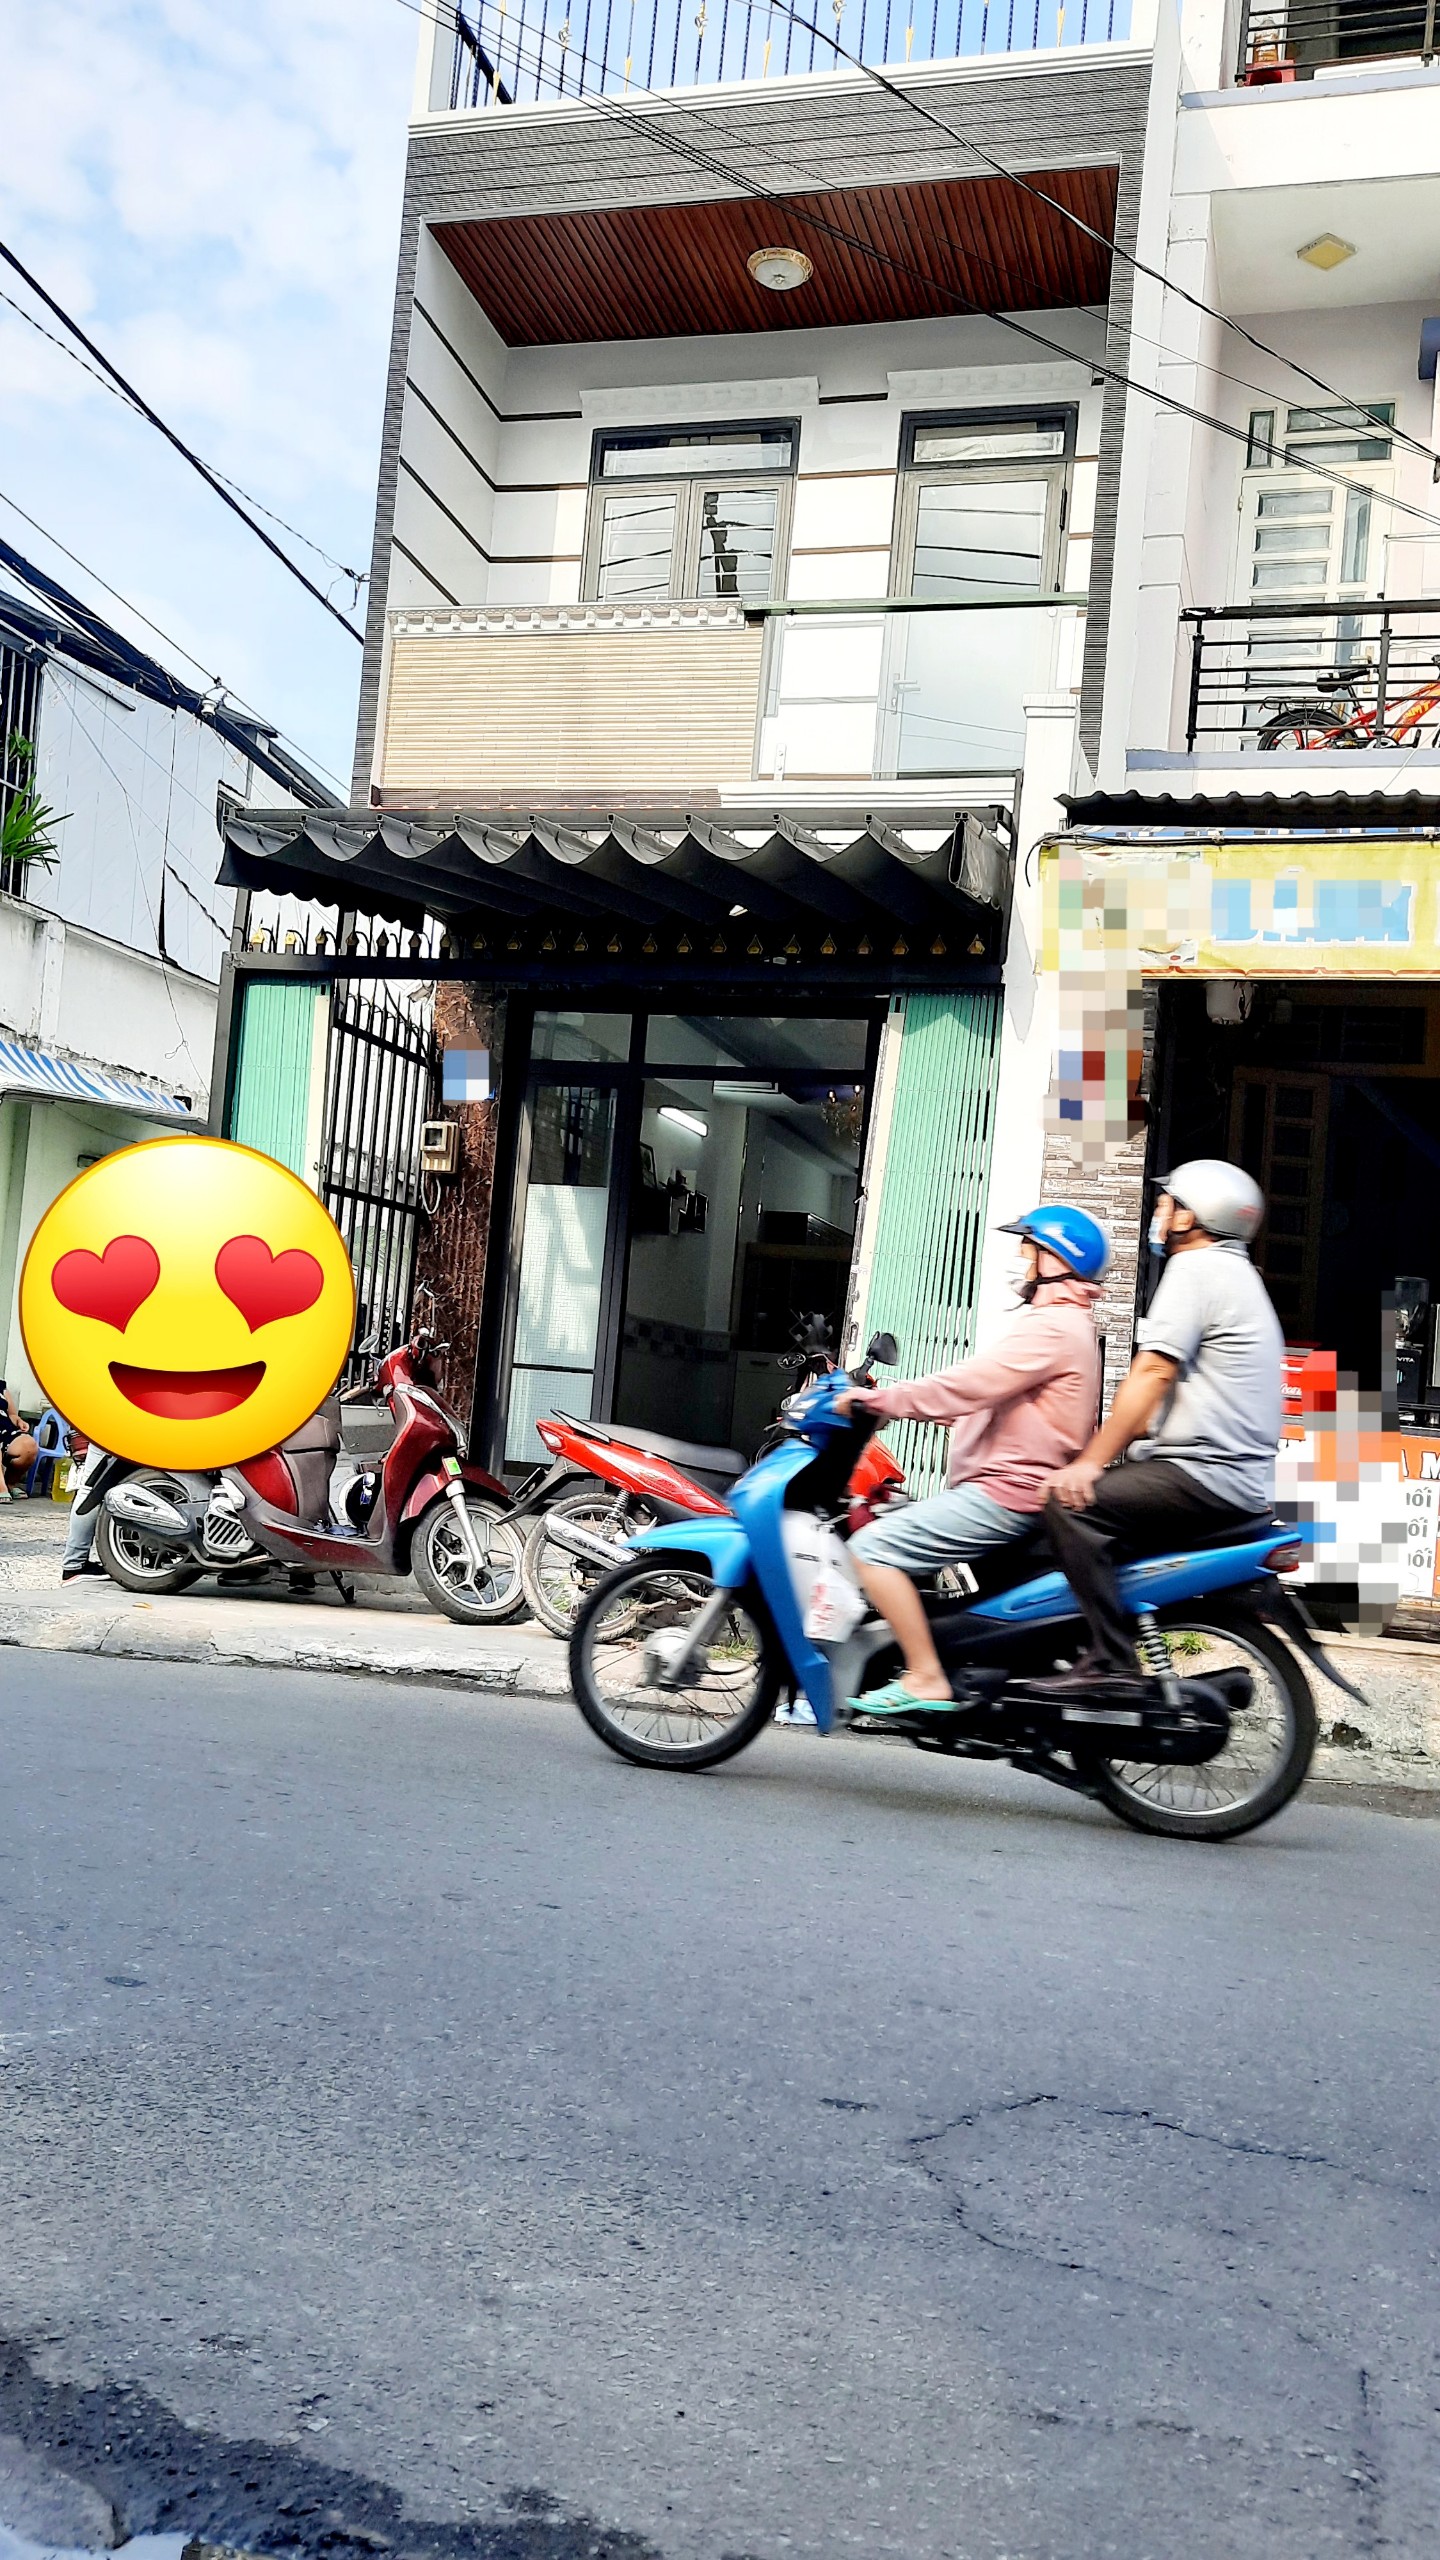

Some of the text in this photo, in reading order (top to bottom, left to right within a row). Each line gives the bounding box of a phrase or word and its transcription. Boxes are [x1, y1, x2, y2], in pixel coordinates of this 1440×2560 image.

[1406, 1486, 1432, 1508] ối
[1408, 1516, 1429, 1538] ối
[1408, 1547, 1433, 1569] ối
